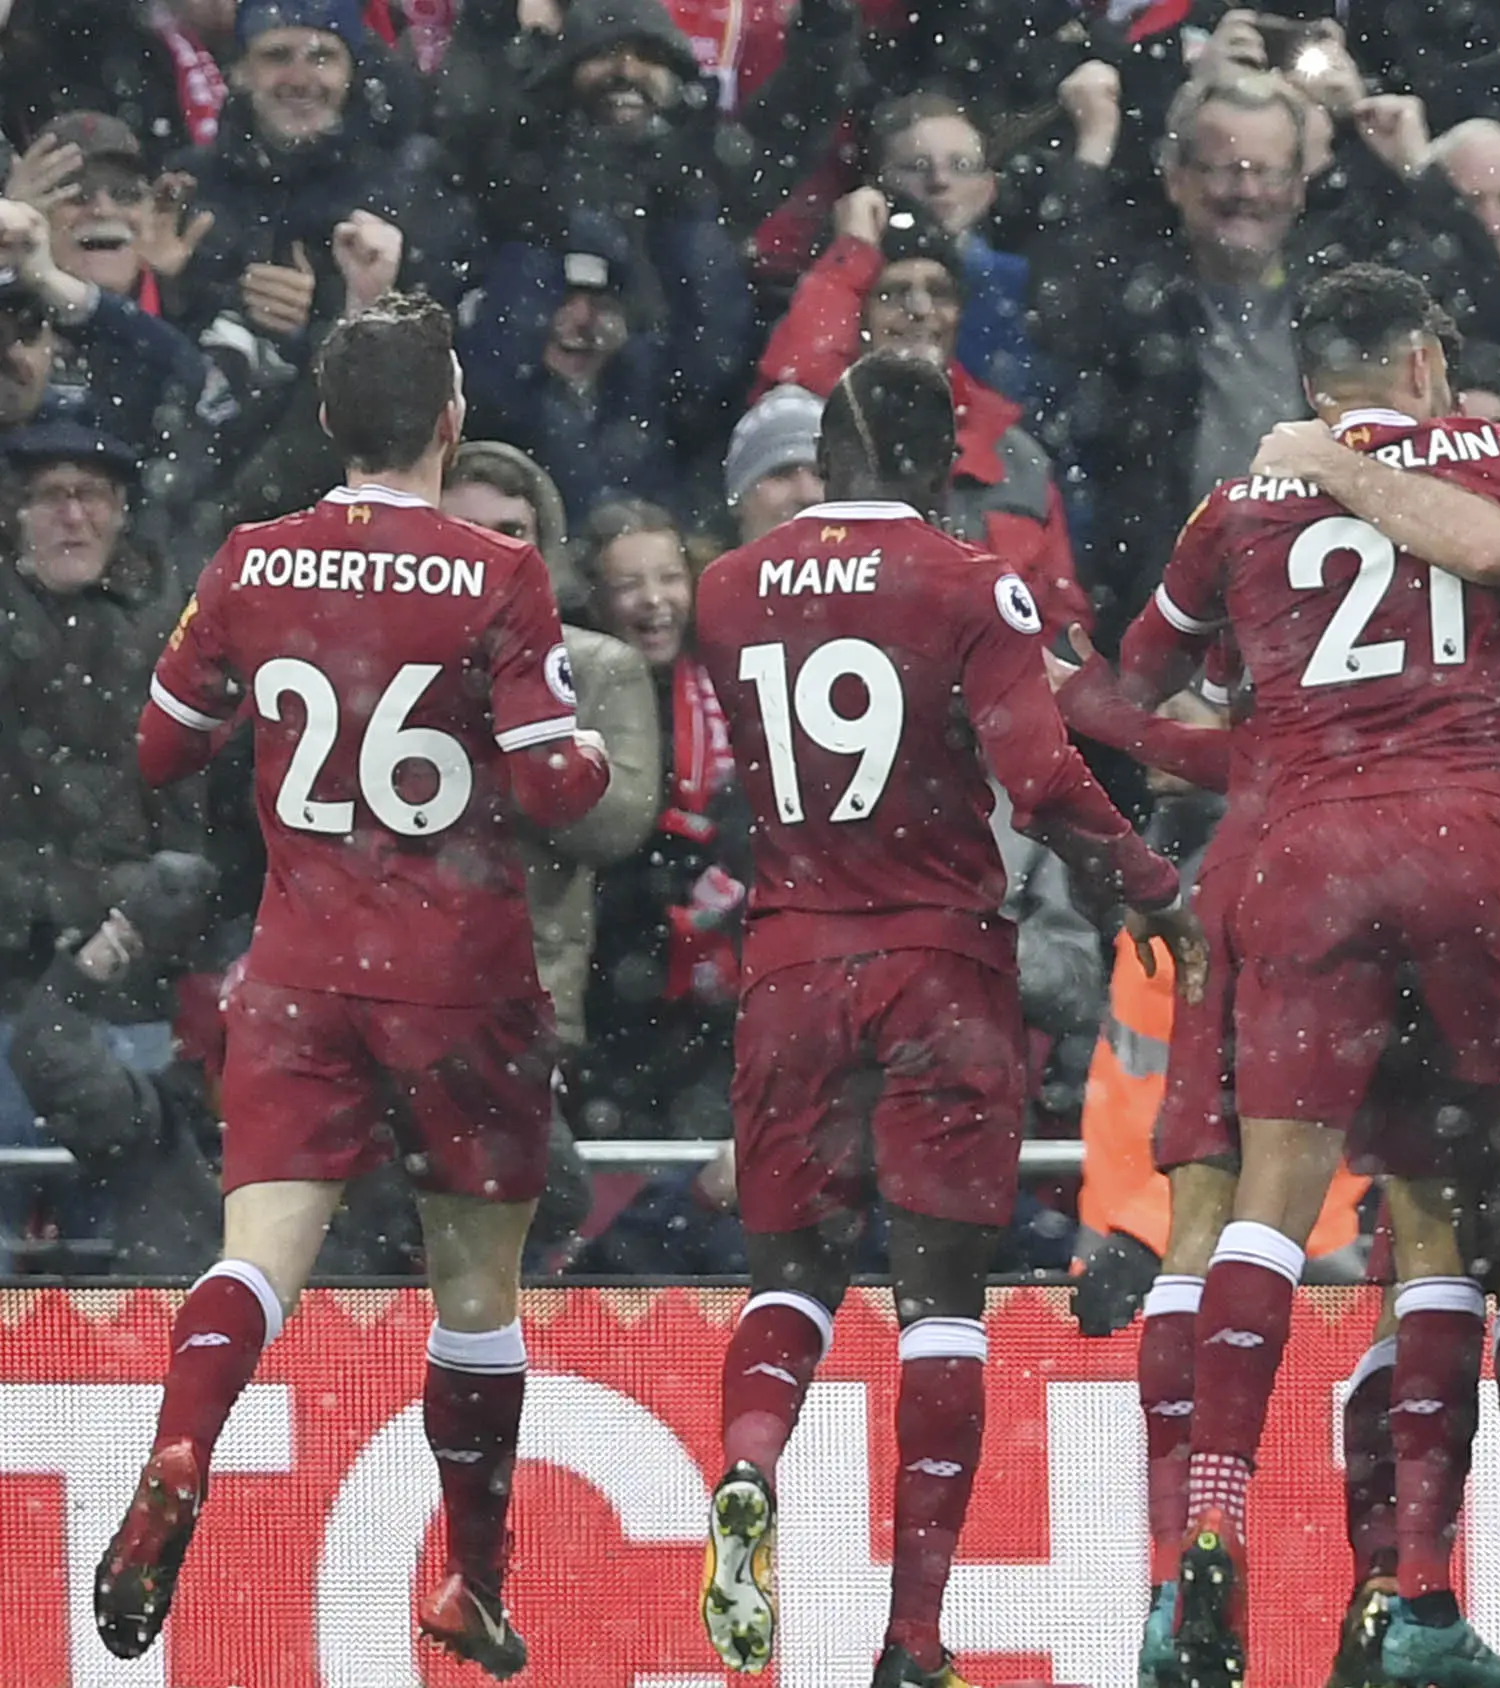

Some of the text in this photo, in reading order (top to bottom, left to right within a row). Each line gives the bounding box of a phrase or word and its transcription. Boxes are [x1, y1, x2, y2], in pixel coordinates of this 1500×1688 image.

[1228, 425, 1500, 502] CHARLAIN
[239, 548, 485, 597] ROBERTSON
[758, 548, 882, 597] MANÉ
[1287, 516, 1465, 687] 21
[254, 658, 472, 836] 26
[739, 638, 904, 824] 19
